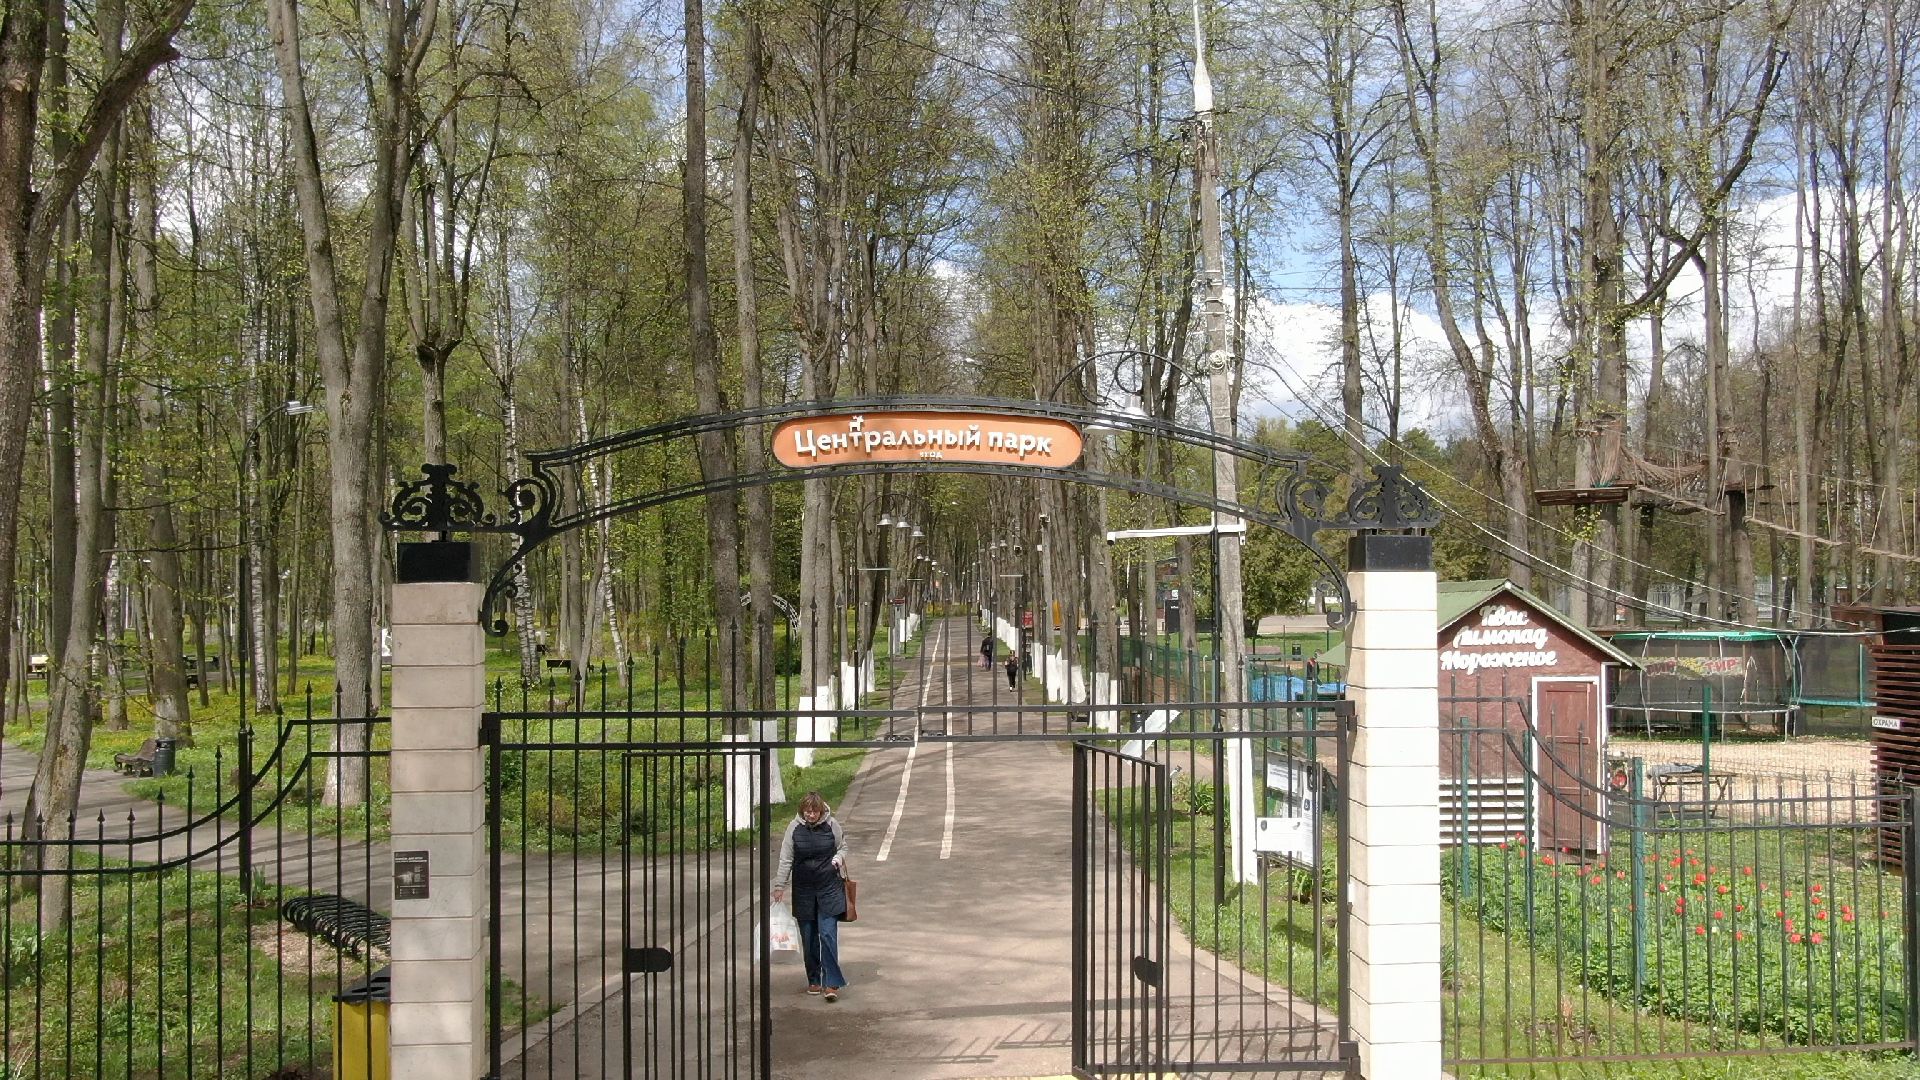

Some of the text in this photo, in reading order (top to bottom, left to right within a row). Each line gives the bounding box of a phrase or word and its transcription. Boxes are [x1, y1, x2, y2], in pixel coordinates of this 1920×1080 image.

[794, 424, 1053, 457] Центральный парк
[1479, 605, 1530, 627] Квас
[1453, 626, 1549, 649] Лимонад
[1440, 650, 1558, 676] Мороженое
[1873, 718, 1898, 728] ОХРАНА
